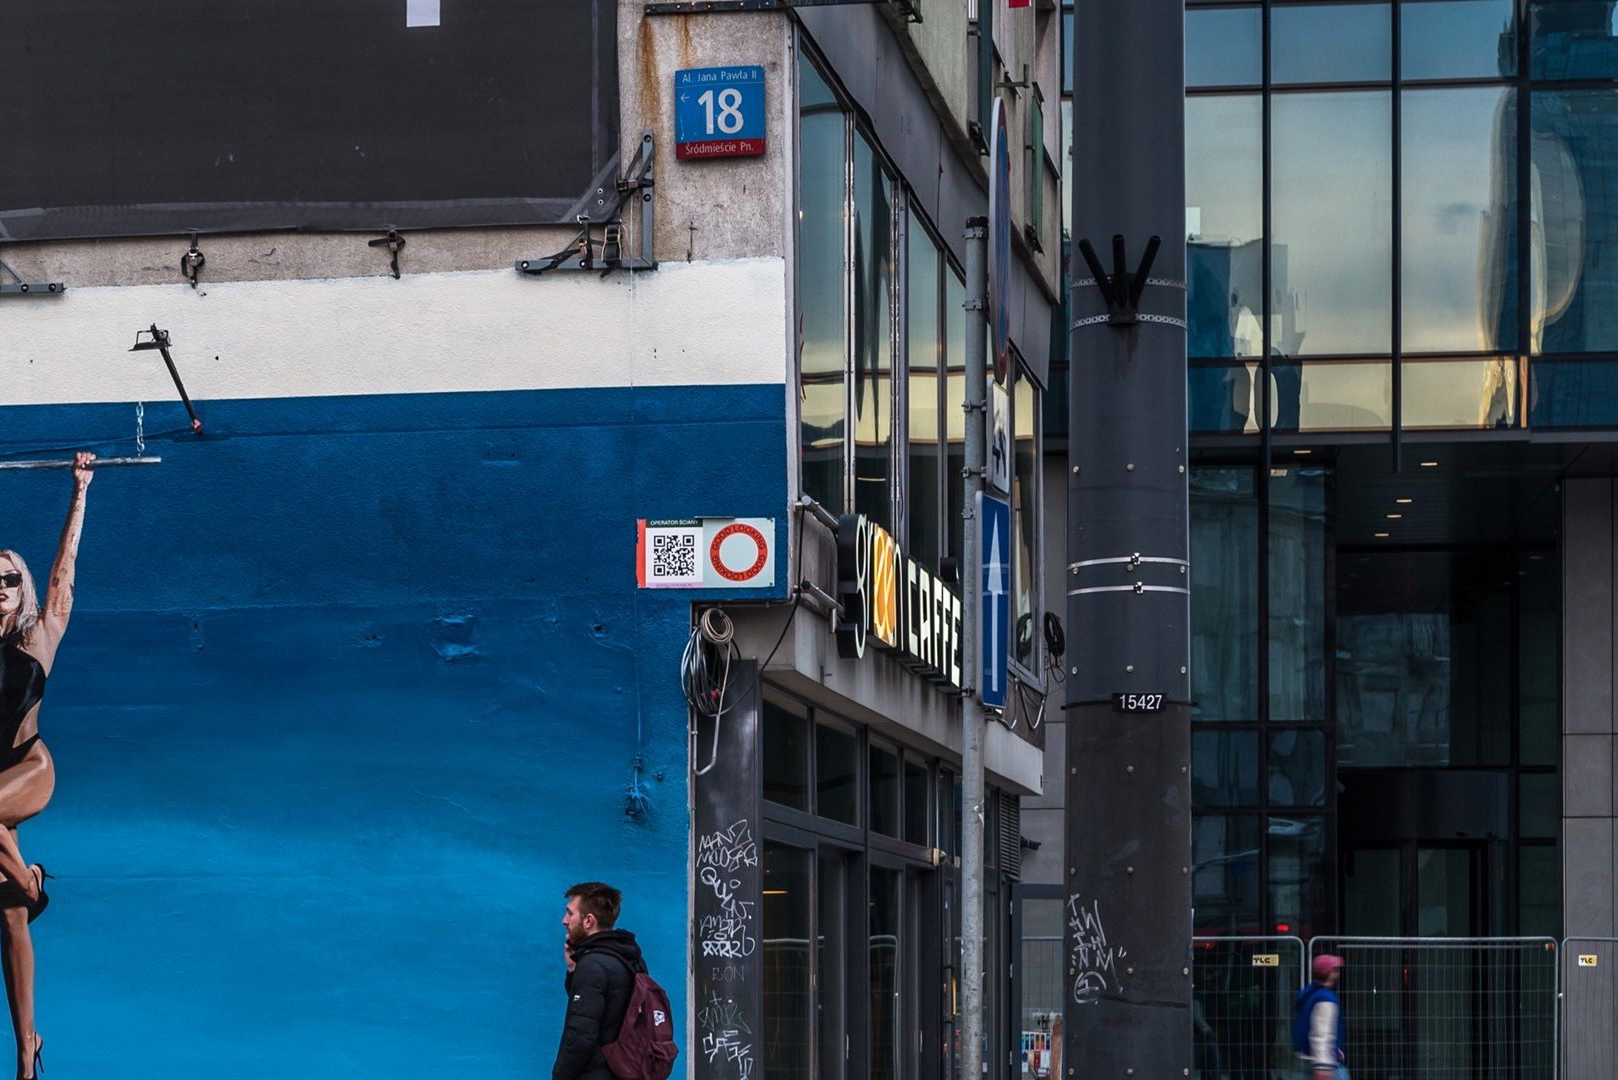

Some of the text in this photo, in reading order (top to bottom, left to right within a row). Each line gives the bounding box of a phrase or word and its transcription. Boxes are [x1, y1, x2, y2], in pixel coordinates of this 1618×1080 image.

[697, 73, 717, 82] Jana
[720, 70, 748, 80] Pawła
[751, 70, 757, 79] II
[697, 88, 744, 135] 18
[685, 141, 755, 155] Śródmieście Pn.
[712, 524, 767, 550] GOOD LOOKING
[907, 558, 961, 688] CAFFE
[1120, 694, 1162, 709] 15427
